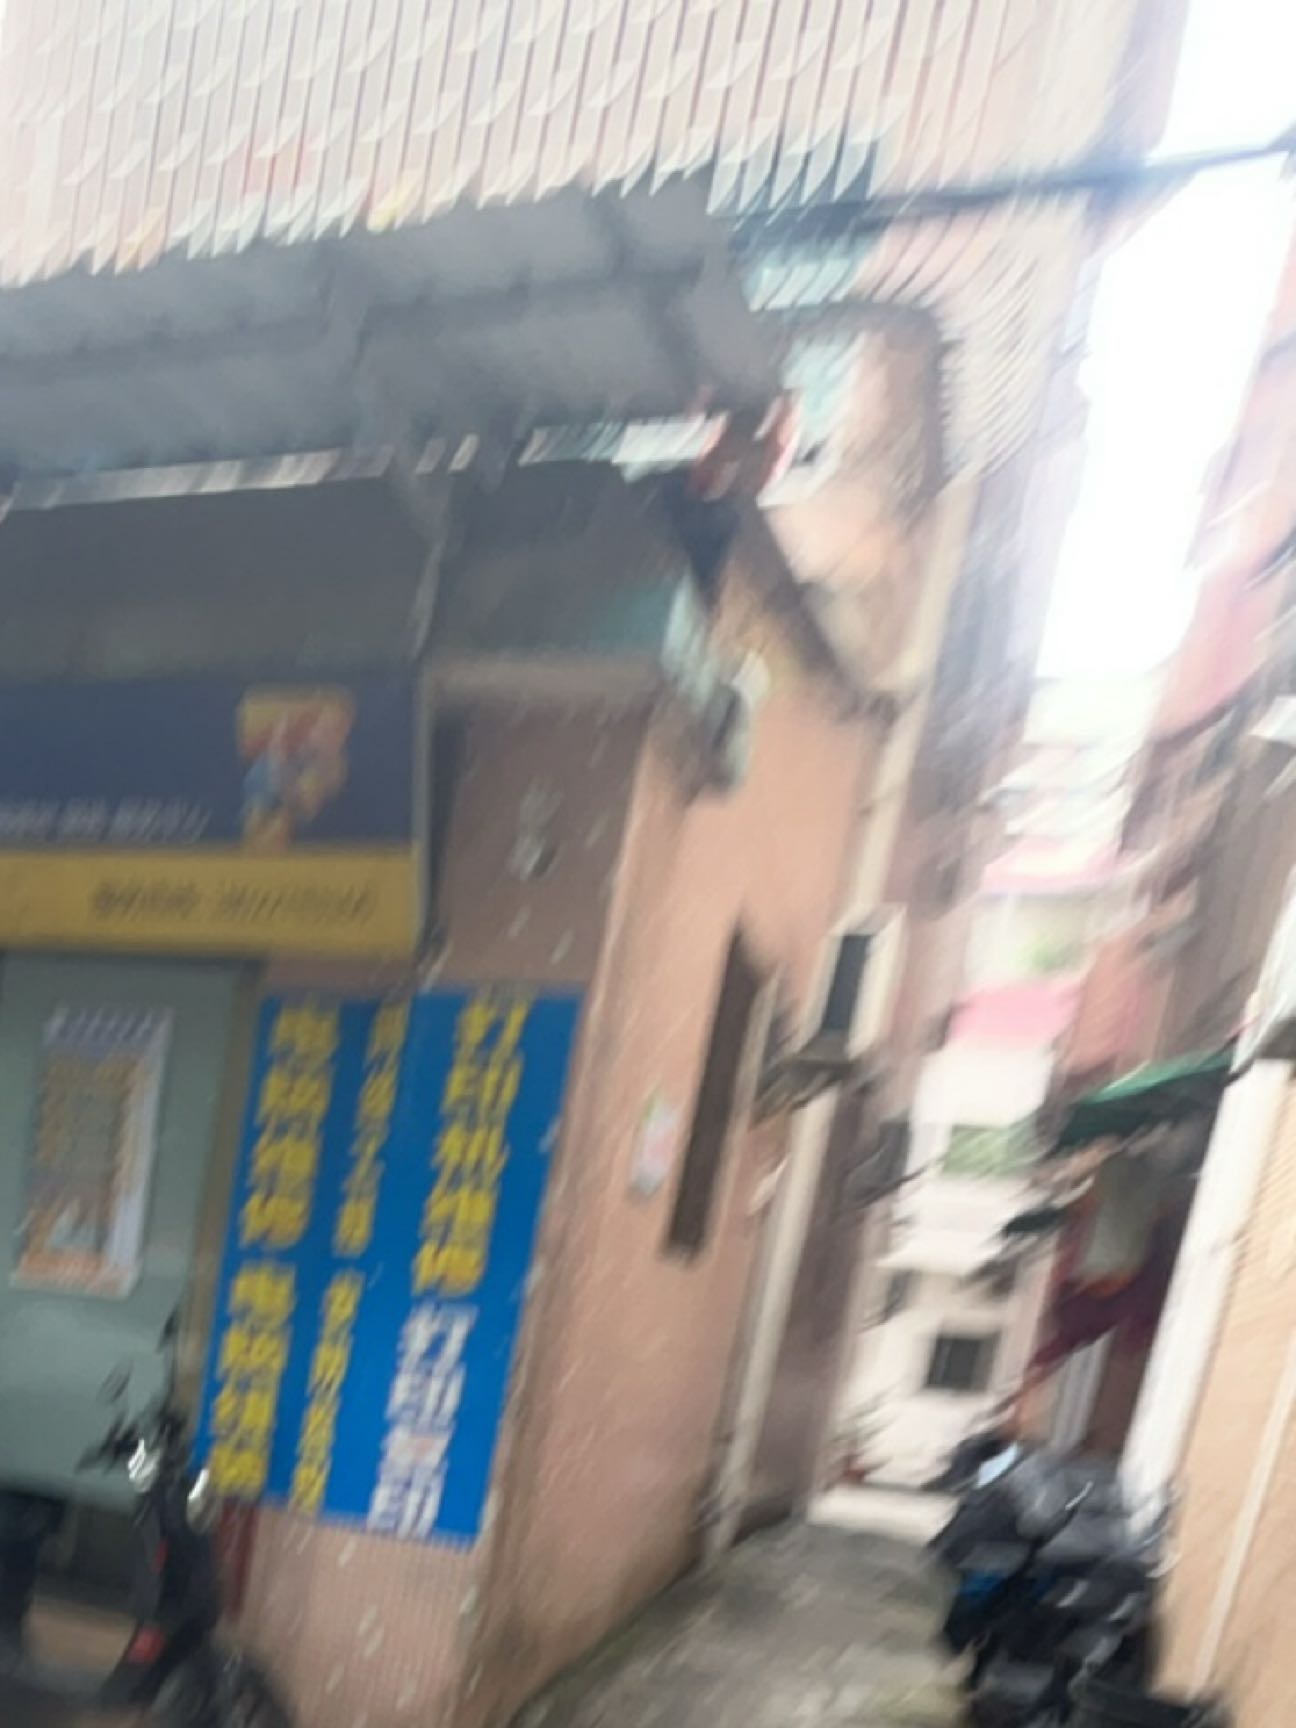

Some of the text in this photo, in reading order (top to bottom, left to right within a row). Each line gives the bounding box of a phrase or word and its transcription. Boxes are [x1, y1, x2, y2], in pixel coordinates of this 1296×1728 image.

[413, 988, 535, 1296] 打印机维修
[367, 1300, 478, 1537] 打印复印
